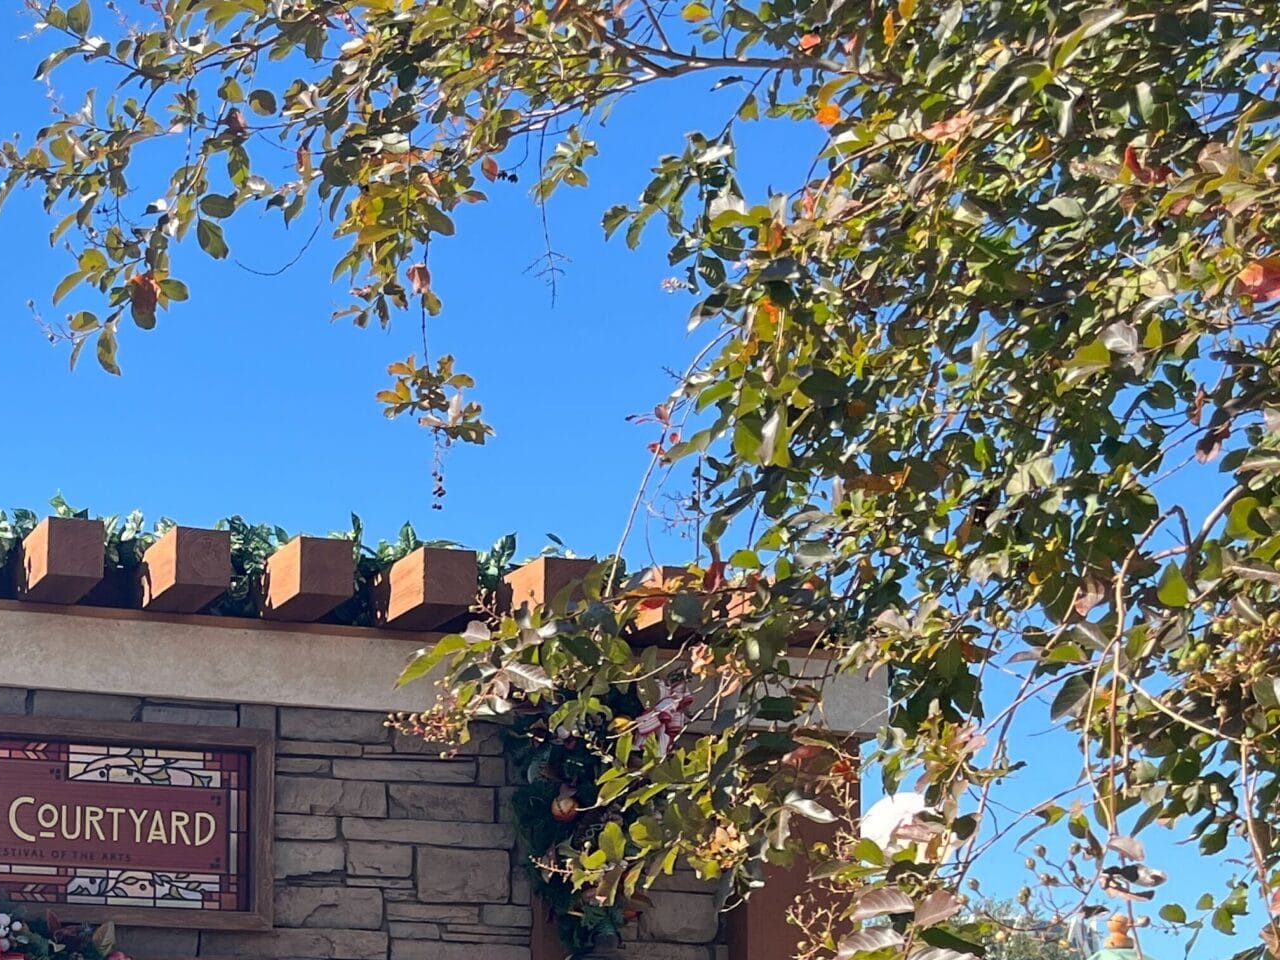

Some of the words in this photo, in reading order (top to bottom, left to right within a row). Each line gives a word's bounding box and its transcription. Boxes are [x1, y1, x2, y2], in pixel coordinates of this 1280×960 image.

[8, 796, 217, 847] COURTYARD
[51, 850, 66, 859] OF
[71, 851, 95, 860] THE
[101, 853, 132, 862] ARTS
